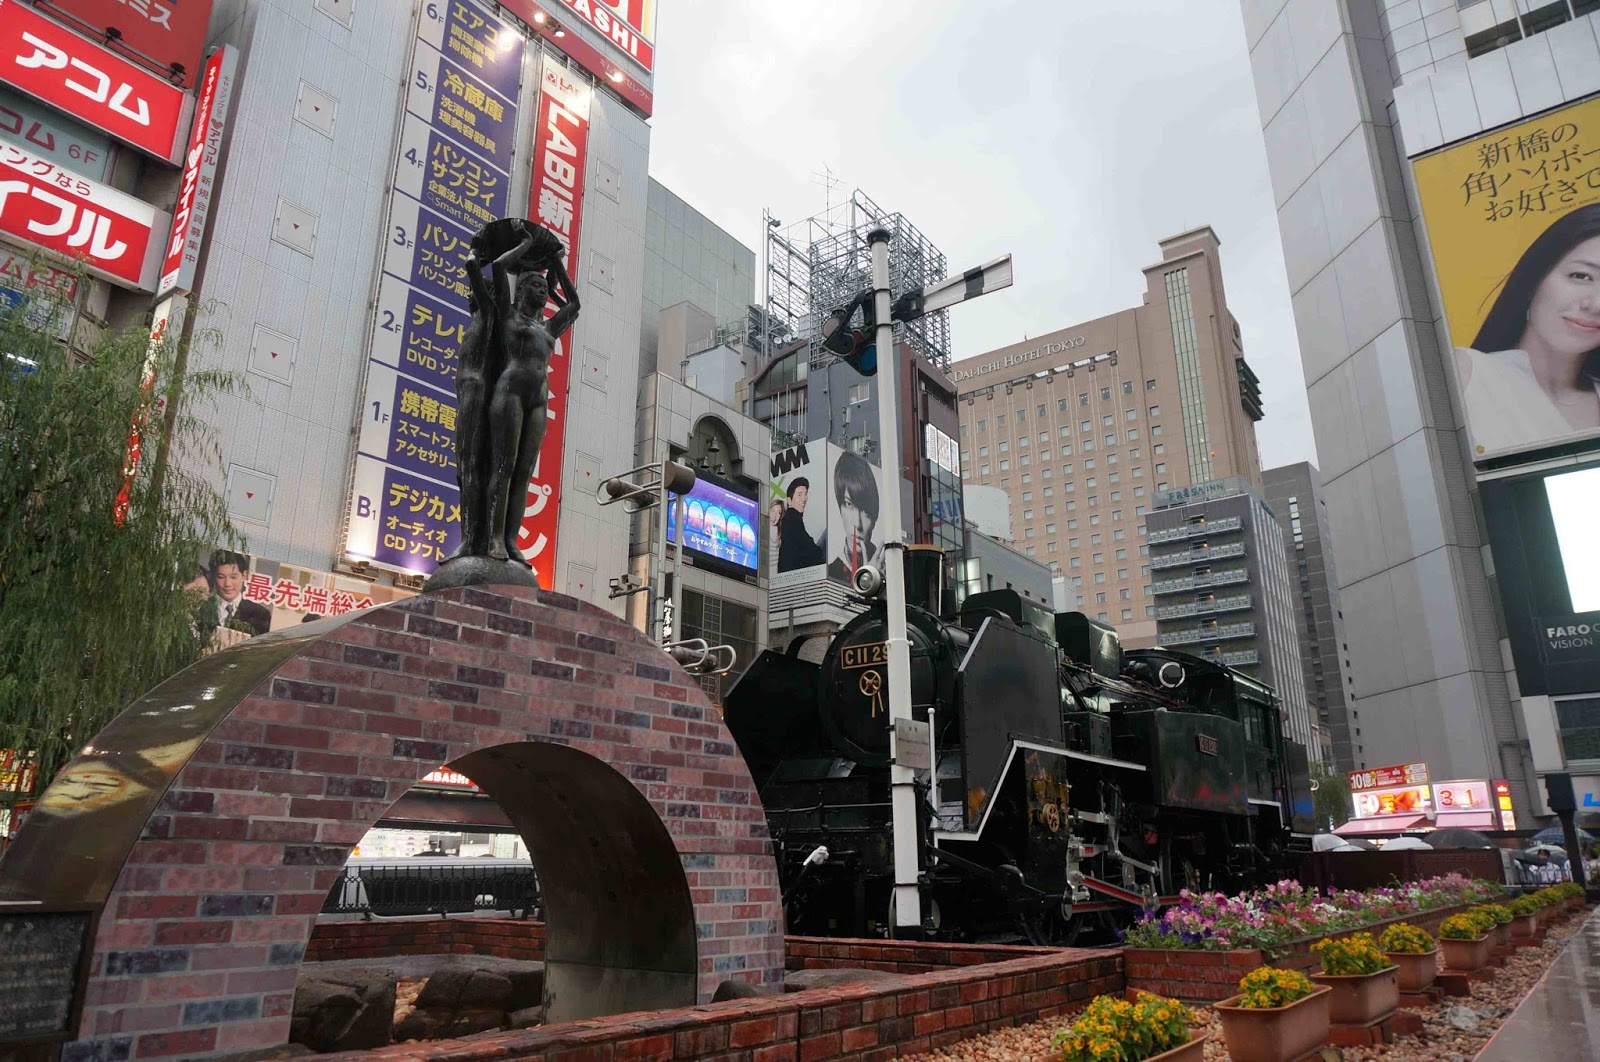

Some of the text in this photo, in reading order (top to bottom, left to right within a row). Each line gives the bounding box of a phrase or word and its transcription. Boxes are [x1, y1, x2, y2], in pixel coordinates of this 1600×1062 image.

[427, 3, 444, 24] 6F
[452, 2, 500, 46] エアコ
[566, 0, 638, 57] ASHI
[15, 31, 150, 126] アコム
[415, 70, 435, 94] 5F
[440, 94, 476, 126] 洗濯機
[443, 69, 504, 123] 冷蔵庫
[438, 108, 496, 154] 理美容器具
[1477, 123, 1578, 169] 新橋の
[68, 144, 99, 163] 6F
[204, 127, 221, 166] アイフル
[404, 147, 424, 169] 4F
[0, 145, 91, 196] ングなら
[432, 141, 497, 187] パソコン
[431, 159, 495, 207] サプライ
[168, 167, 198, 258] アイフル
[185, 174, 211, 263] 新規会員募集中
[434, 197, 462, 219] Smart
[393, 226, 413, 250] 3F
[421, 248, 467, 278] プリンタ
[381, 310, 402, 333] 2F
[406, 347, 437, 371] DVD
[953, 336, 1086, 382] DAI-ICHI HOTEL TOKYO
[372, 401, 389, 424] 1F
[400, 388, 459, 431] 携帯電
[395, 438, 458, 468] アクセサリー
[357, 496, 376, 521] B1
[389, 482, 462, 523] デジカメ
[386, 515, 448, 544] オーディオ
[384, 533, 445, 562] CD ソフト
[1546, 624, 1590, 638] FARO
[1550, 637, 1593, 649] VISION
[421, 771, 470, 784] BASHI
